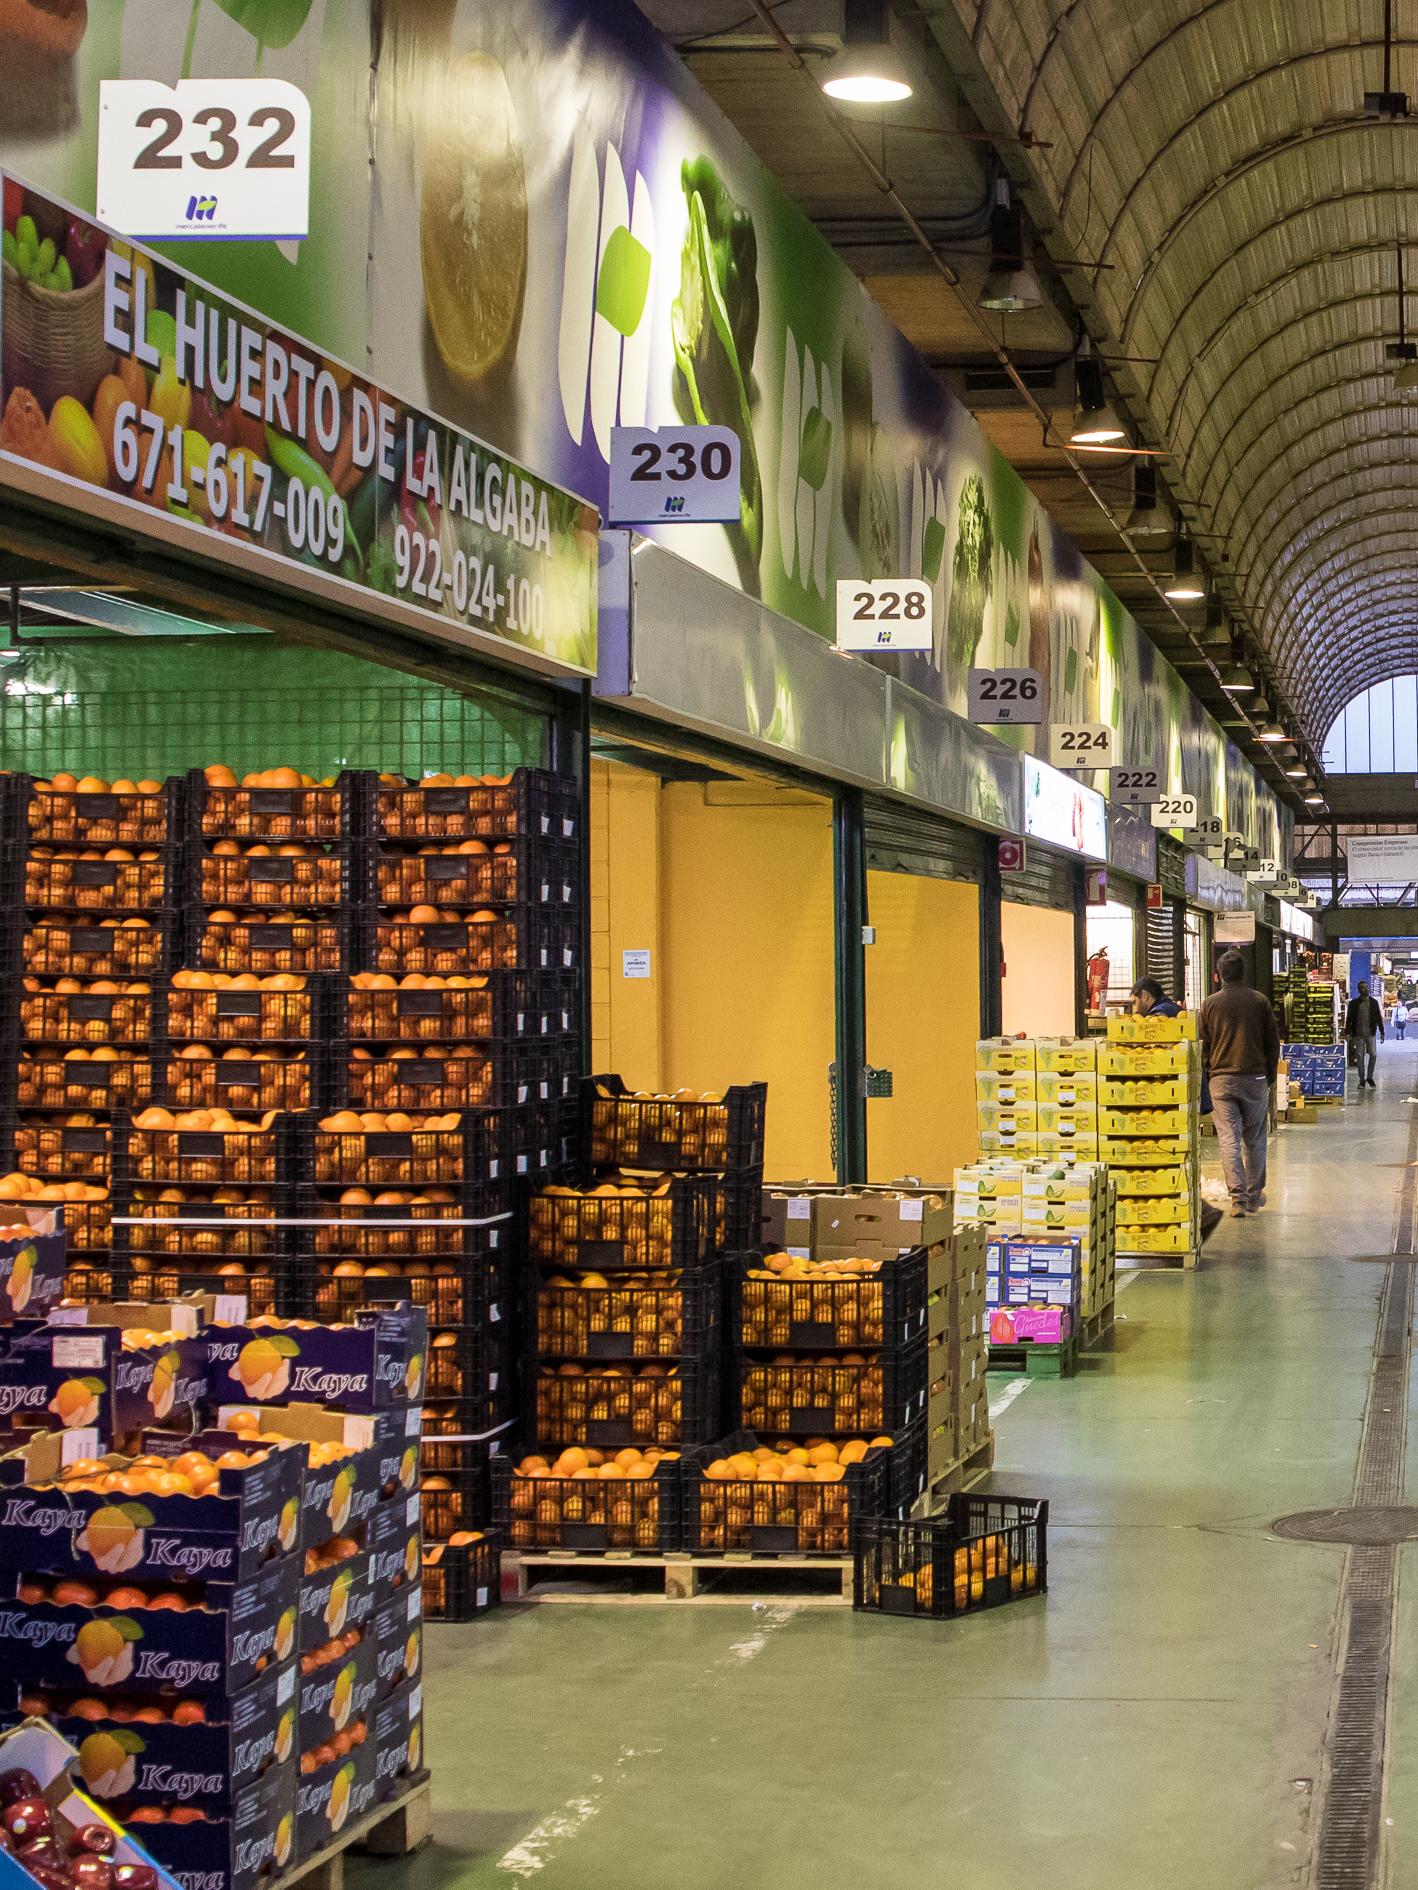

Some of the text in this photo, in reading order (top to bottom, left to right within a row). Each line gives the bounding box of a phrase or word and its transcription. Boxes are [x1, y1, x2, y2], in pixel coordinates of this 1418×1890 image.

[132, 107, 296, 170] 232
[103, 247, 554, 558] EL HUERTO DE LA ALGABA
[630, 441, 732, 481] 230
[113, 400, 546, 640] 671-617-009 922-024-100
[853, 591, 926, 620] 228
[979, 677, 1038, 700] 226
[1060, 731, 1109, 750] 224
[1116, 772, 1158, 788] 222
[1158, 800, 1194, 815] 220
[116, 1360, 154, 1394] Kaya
[290, 1366, 369, 1399] Kaya
[2, 1499, 87, 1536] Kaya
[241, 1514, 279, 1552] Kaya
[147, 1538, 233, 1575] Kaya
[0, 1611, 76, 1648] Kaya
[232, 1624, 276, 1665] Kaya
[136, 1651, 220, 1688] Kaya
[232, 1729, 275, 1776] Kaya
[138, 1764, 224, 1800] Kaya
[233, 1832, 275, 1876] Kaya
